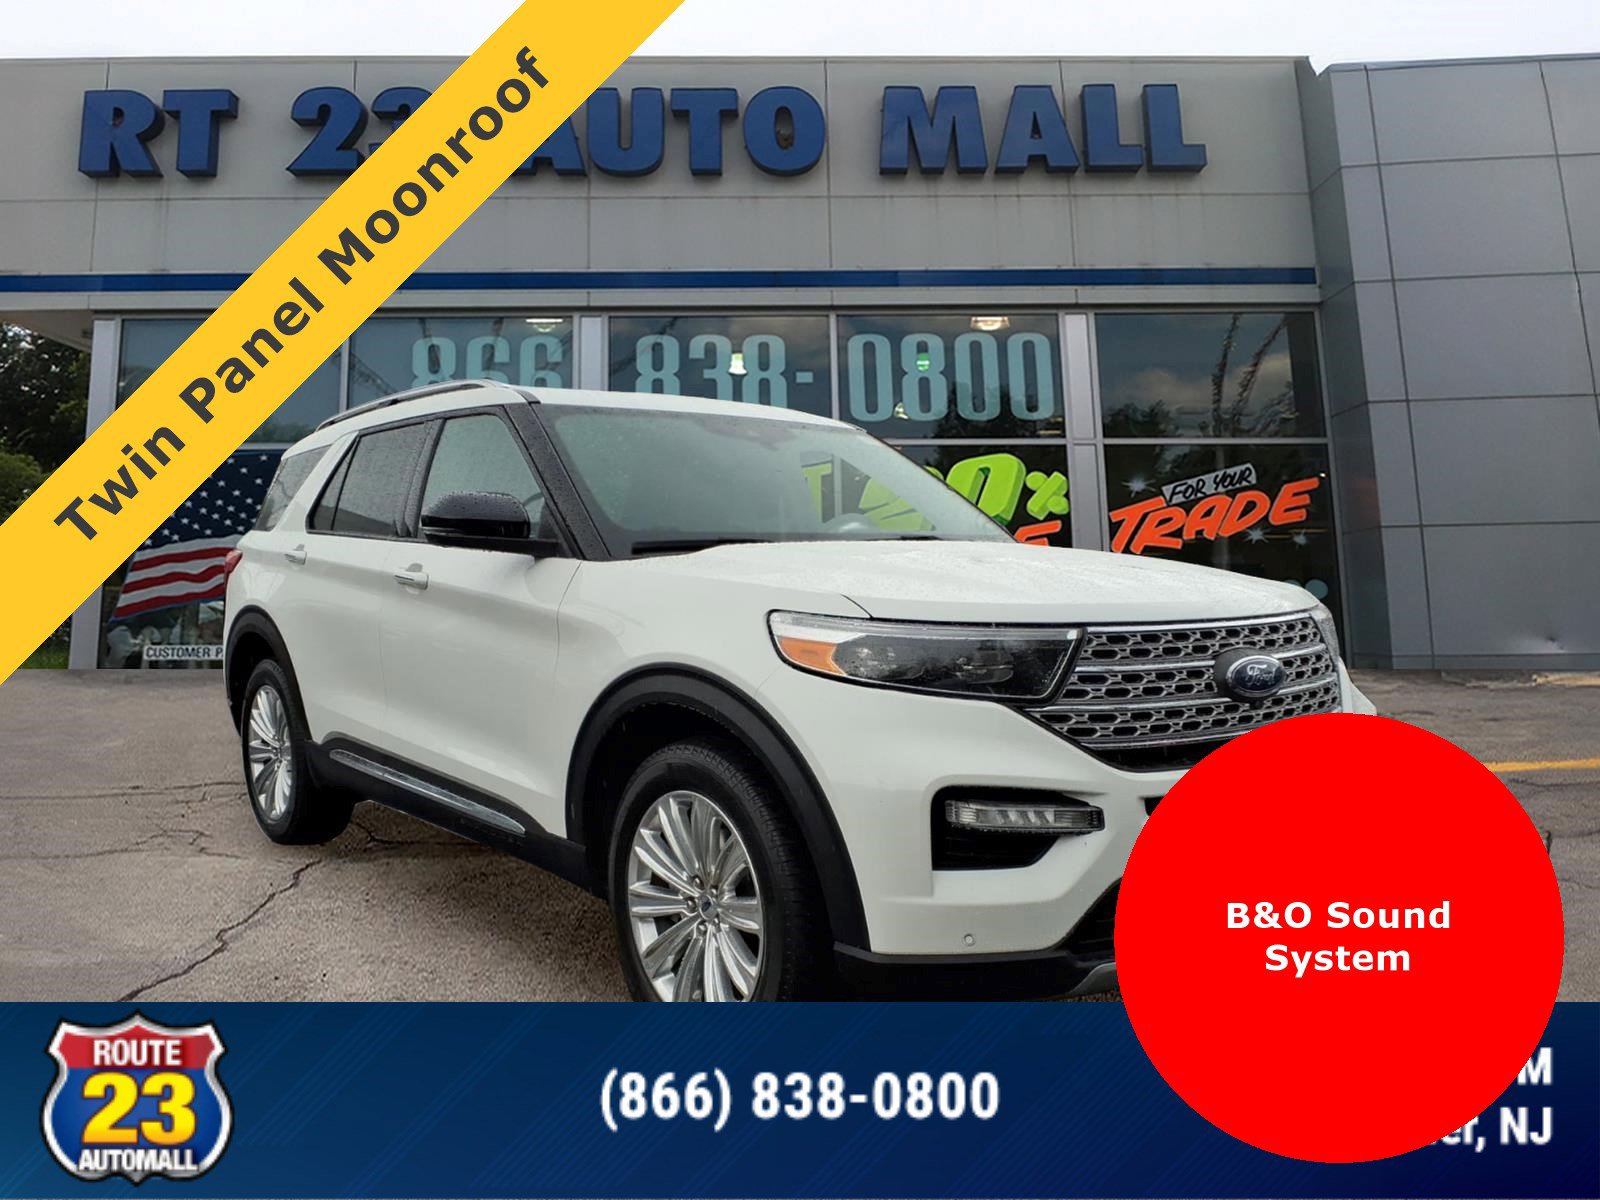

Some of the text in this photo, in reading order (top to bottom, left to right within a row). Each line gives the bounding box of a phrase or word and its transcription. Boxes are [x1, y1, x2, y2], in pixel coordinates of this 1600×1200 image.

[78, 89, 239, 177] RT
[513, 85, 826, 177] AUTO
[880, 84, 1207, 176] MALL
[411, 335, 563, 389] 866
[847, 332, 1054, 422] 0800
[1109, 477, 1320, 555] TRADE
[1169, 466, 1251, 501] FOR YOUR
[146, 646, 211, 658] CUSTOMER
